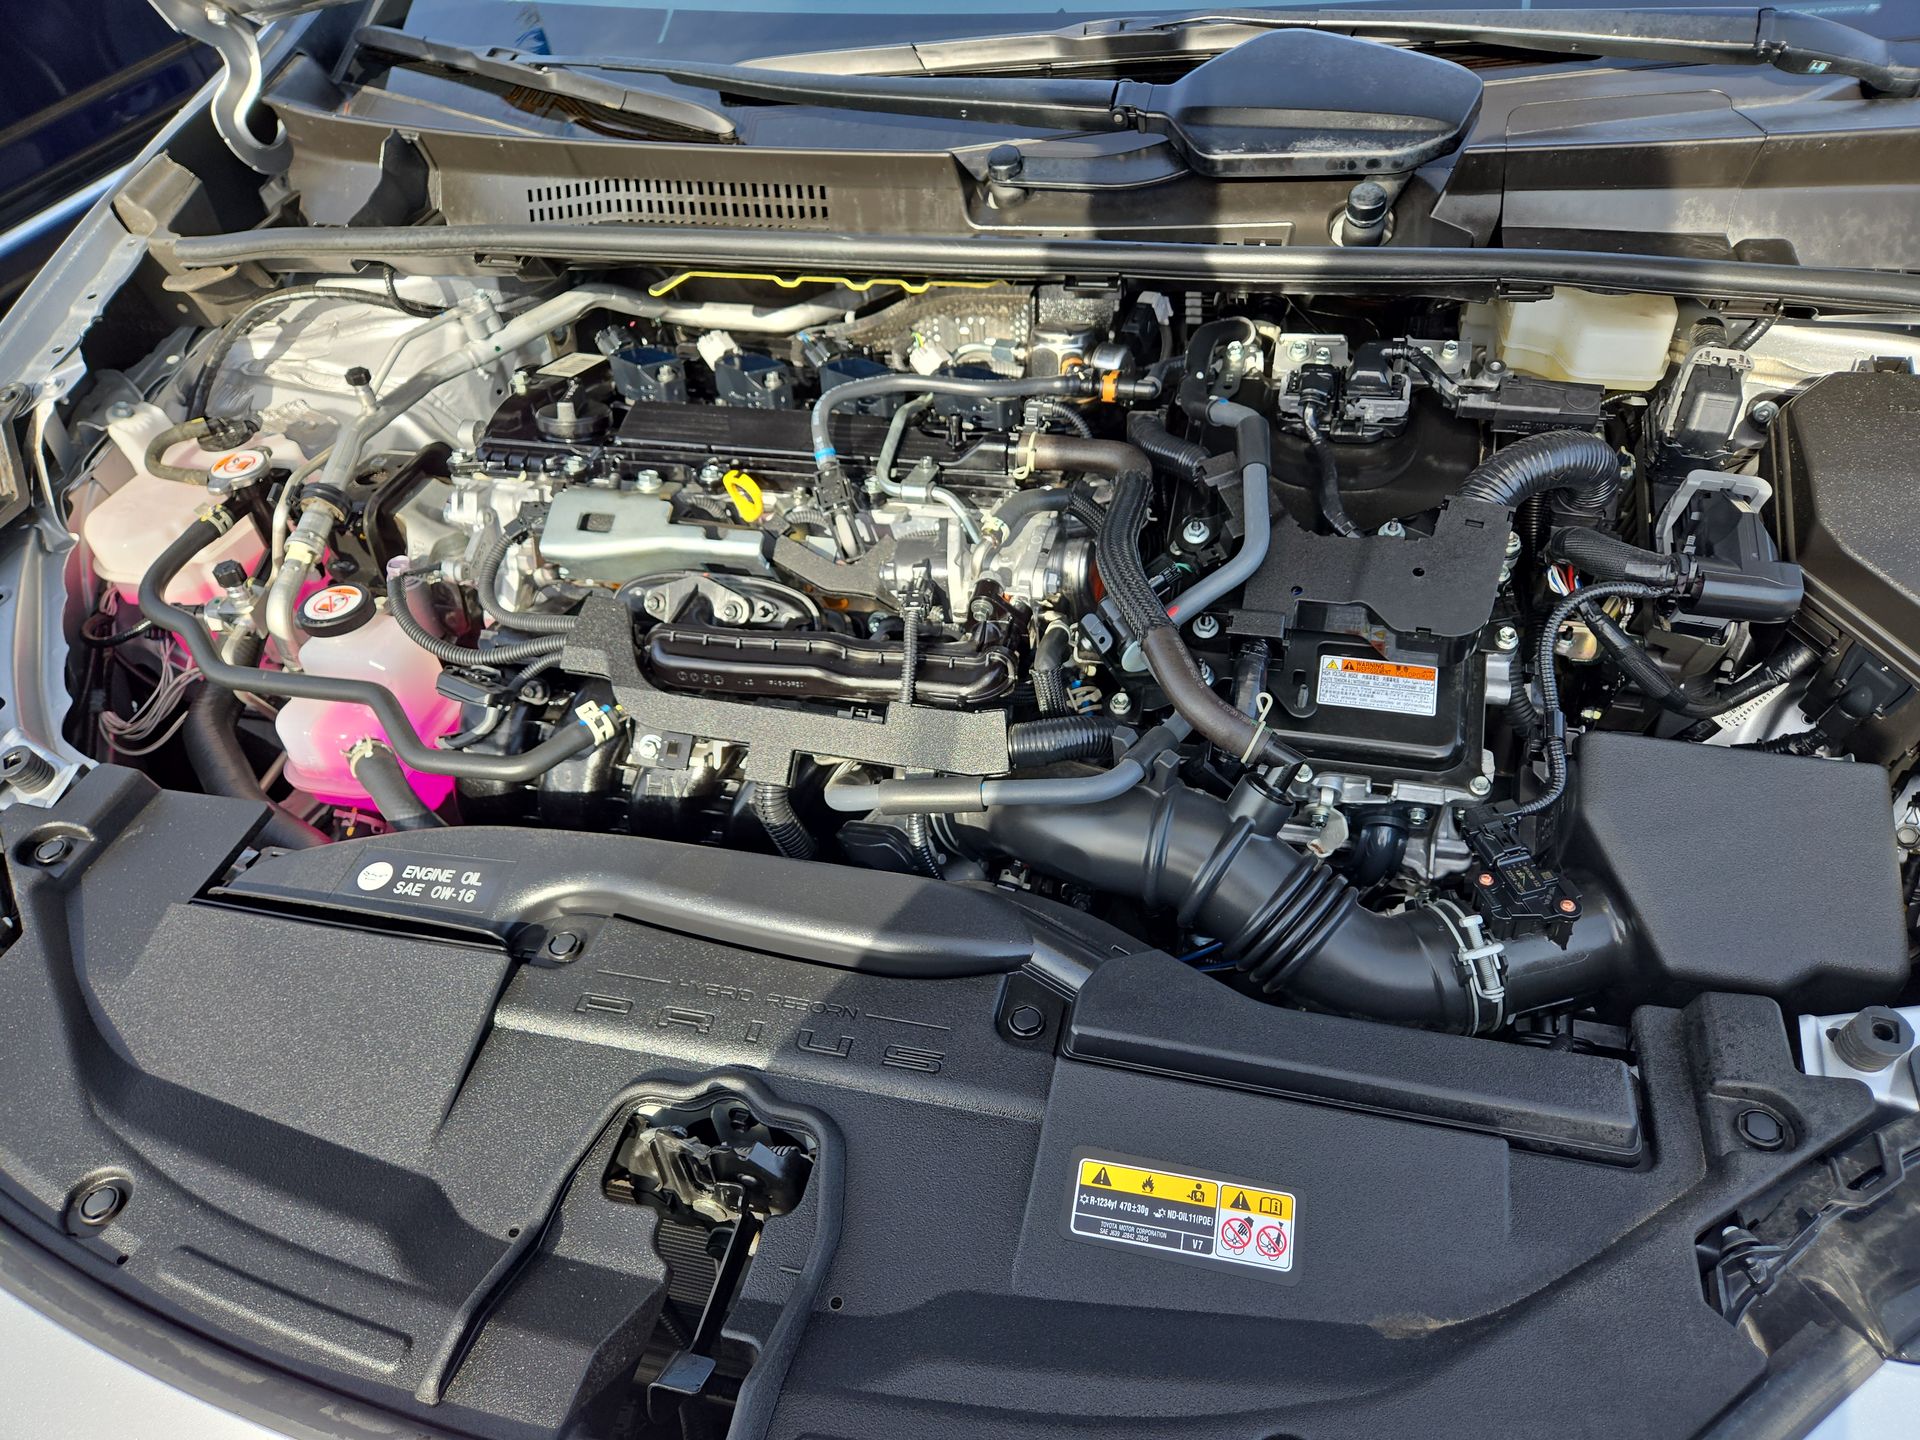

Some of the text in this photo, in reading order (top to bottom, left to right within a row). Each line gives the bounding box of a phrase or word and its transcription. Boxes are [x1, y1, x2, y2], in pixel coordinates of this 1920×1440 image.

[1356, 660, 1385, 670] WARNING
[402, 865, 482, 886] ENGINE OIL
[392, 881, 425, 897] SAE
[677, 979, 860, 1020] HYBRID REBORN
[574, 991, 946, 1074] PRIUS
[1119, 1202, 1149, 1217] 470±30g
[1099, 1228, 1109, 1236] SAE
[1100, 1220, 1167, 1239] TOYOTA MOTOR CORPORATION
[1192, 1239, 1204, 1251] V7
